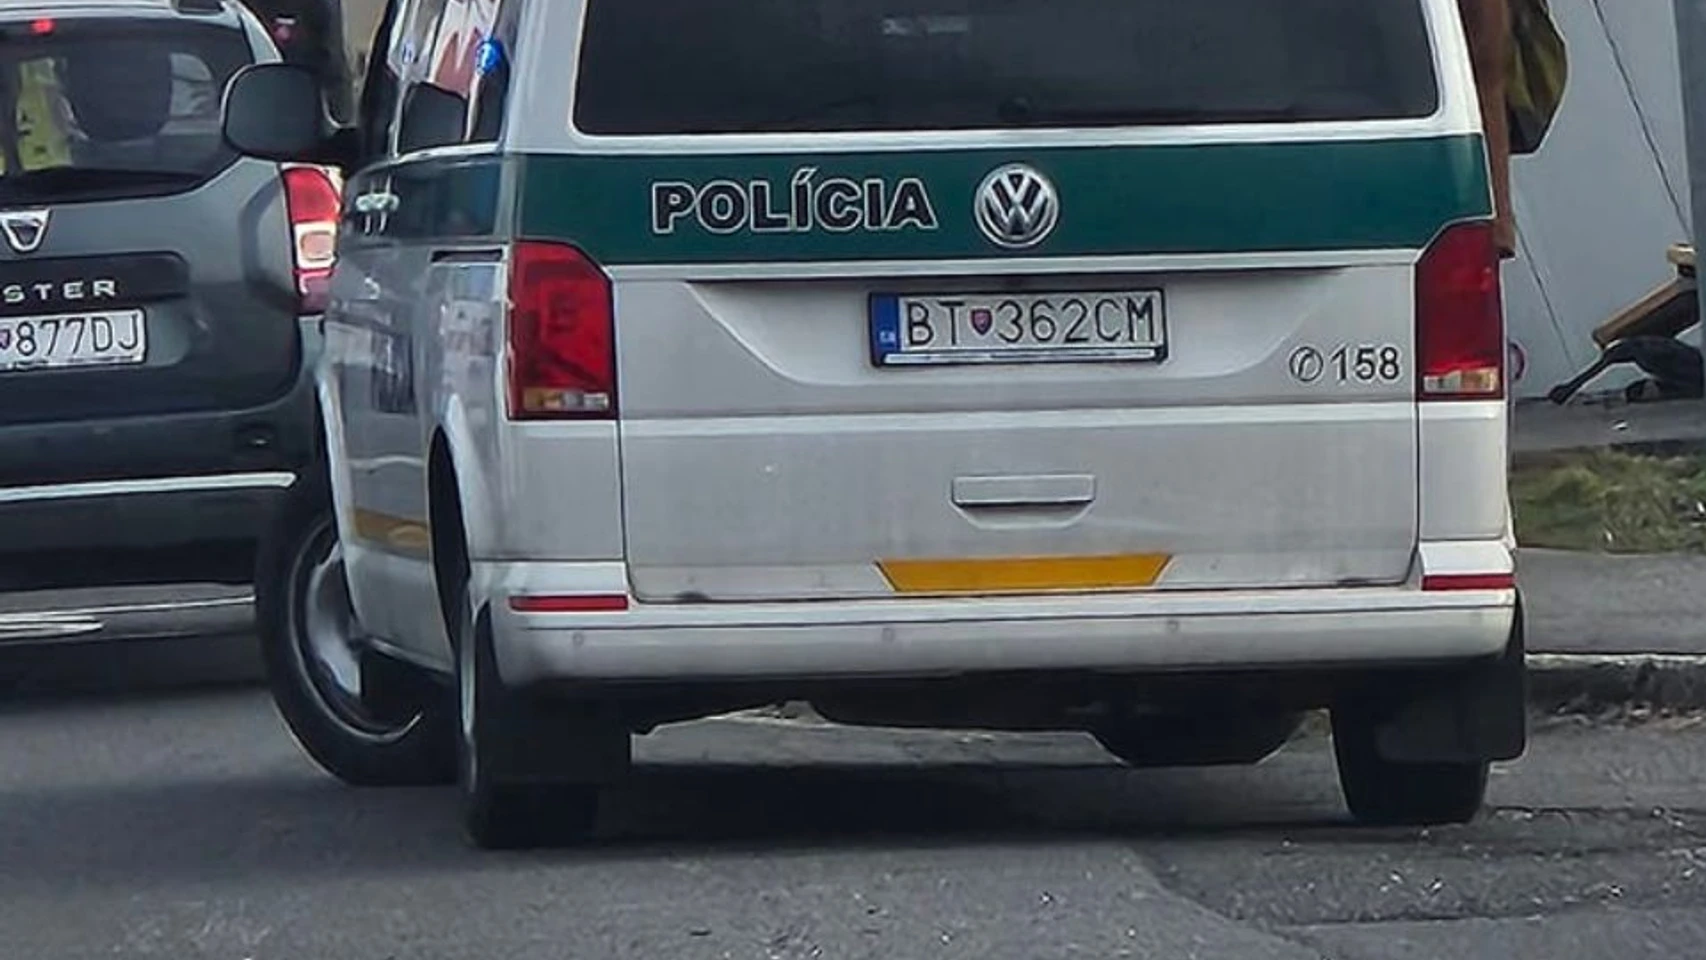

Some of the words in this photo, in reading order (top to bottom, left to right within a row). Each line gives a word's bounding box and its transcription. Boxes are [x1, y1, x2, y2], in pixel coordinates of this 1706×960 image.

[652, 167, 938, 233] POLÍCIA
[15, 313, 140, 357] 877DJ
[1330, 344, 1401, 382] 158
